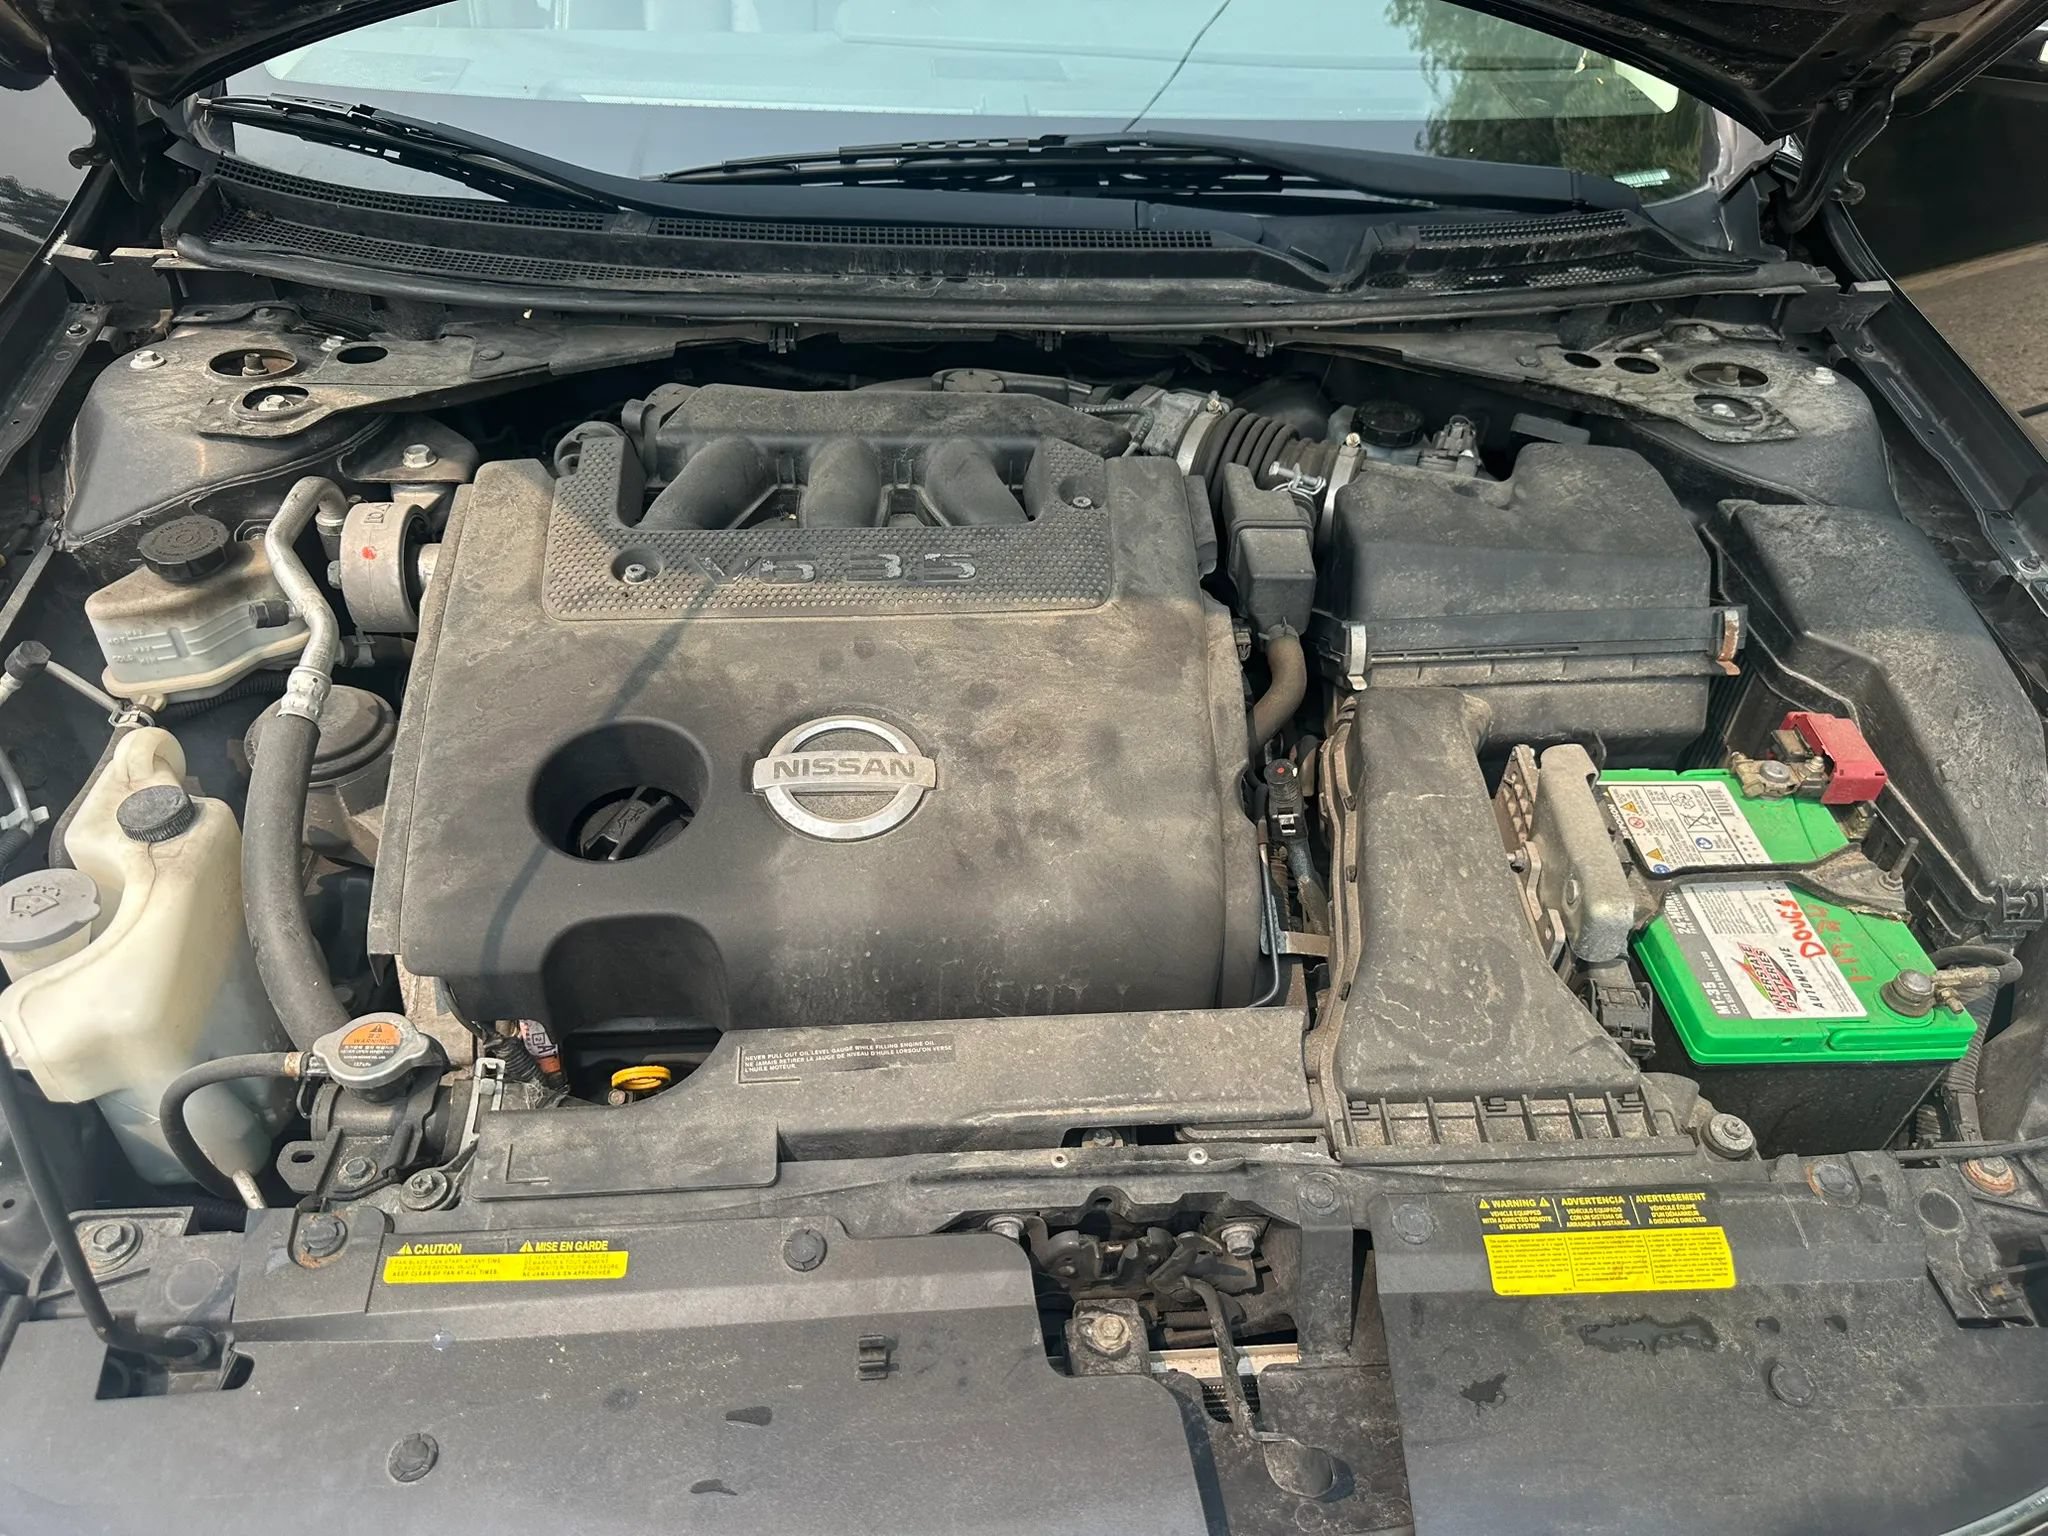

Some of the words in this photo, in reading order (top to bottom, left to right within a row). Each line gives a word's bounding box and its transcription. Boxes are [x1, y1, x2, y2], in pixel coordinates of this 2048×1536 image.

[773, 757, 916, 779] NISSAN
[1740, 945, 1788, 1012] INTERSTATE
[1756, 949, 1798, 1010] BATTERIES
[1778, 946, 1825, 1009] AUTOMOTIVE
[1702, 981, 1731, 1015] MT-35
[1491, 1199, 1536, 1208] WARNING
[1561, 1195, 1625, 1206] ADVERTENCIA
[1635, 1192, 1706, 1204] AVERTISSEMENT
[413, 1243, 462, 1254] CAUTION
[534, 1241, 559, 1252] MISE
[559, 1240, 575, 1251] EN
[574, 1240, 609, 1251] GARDE
